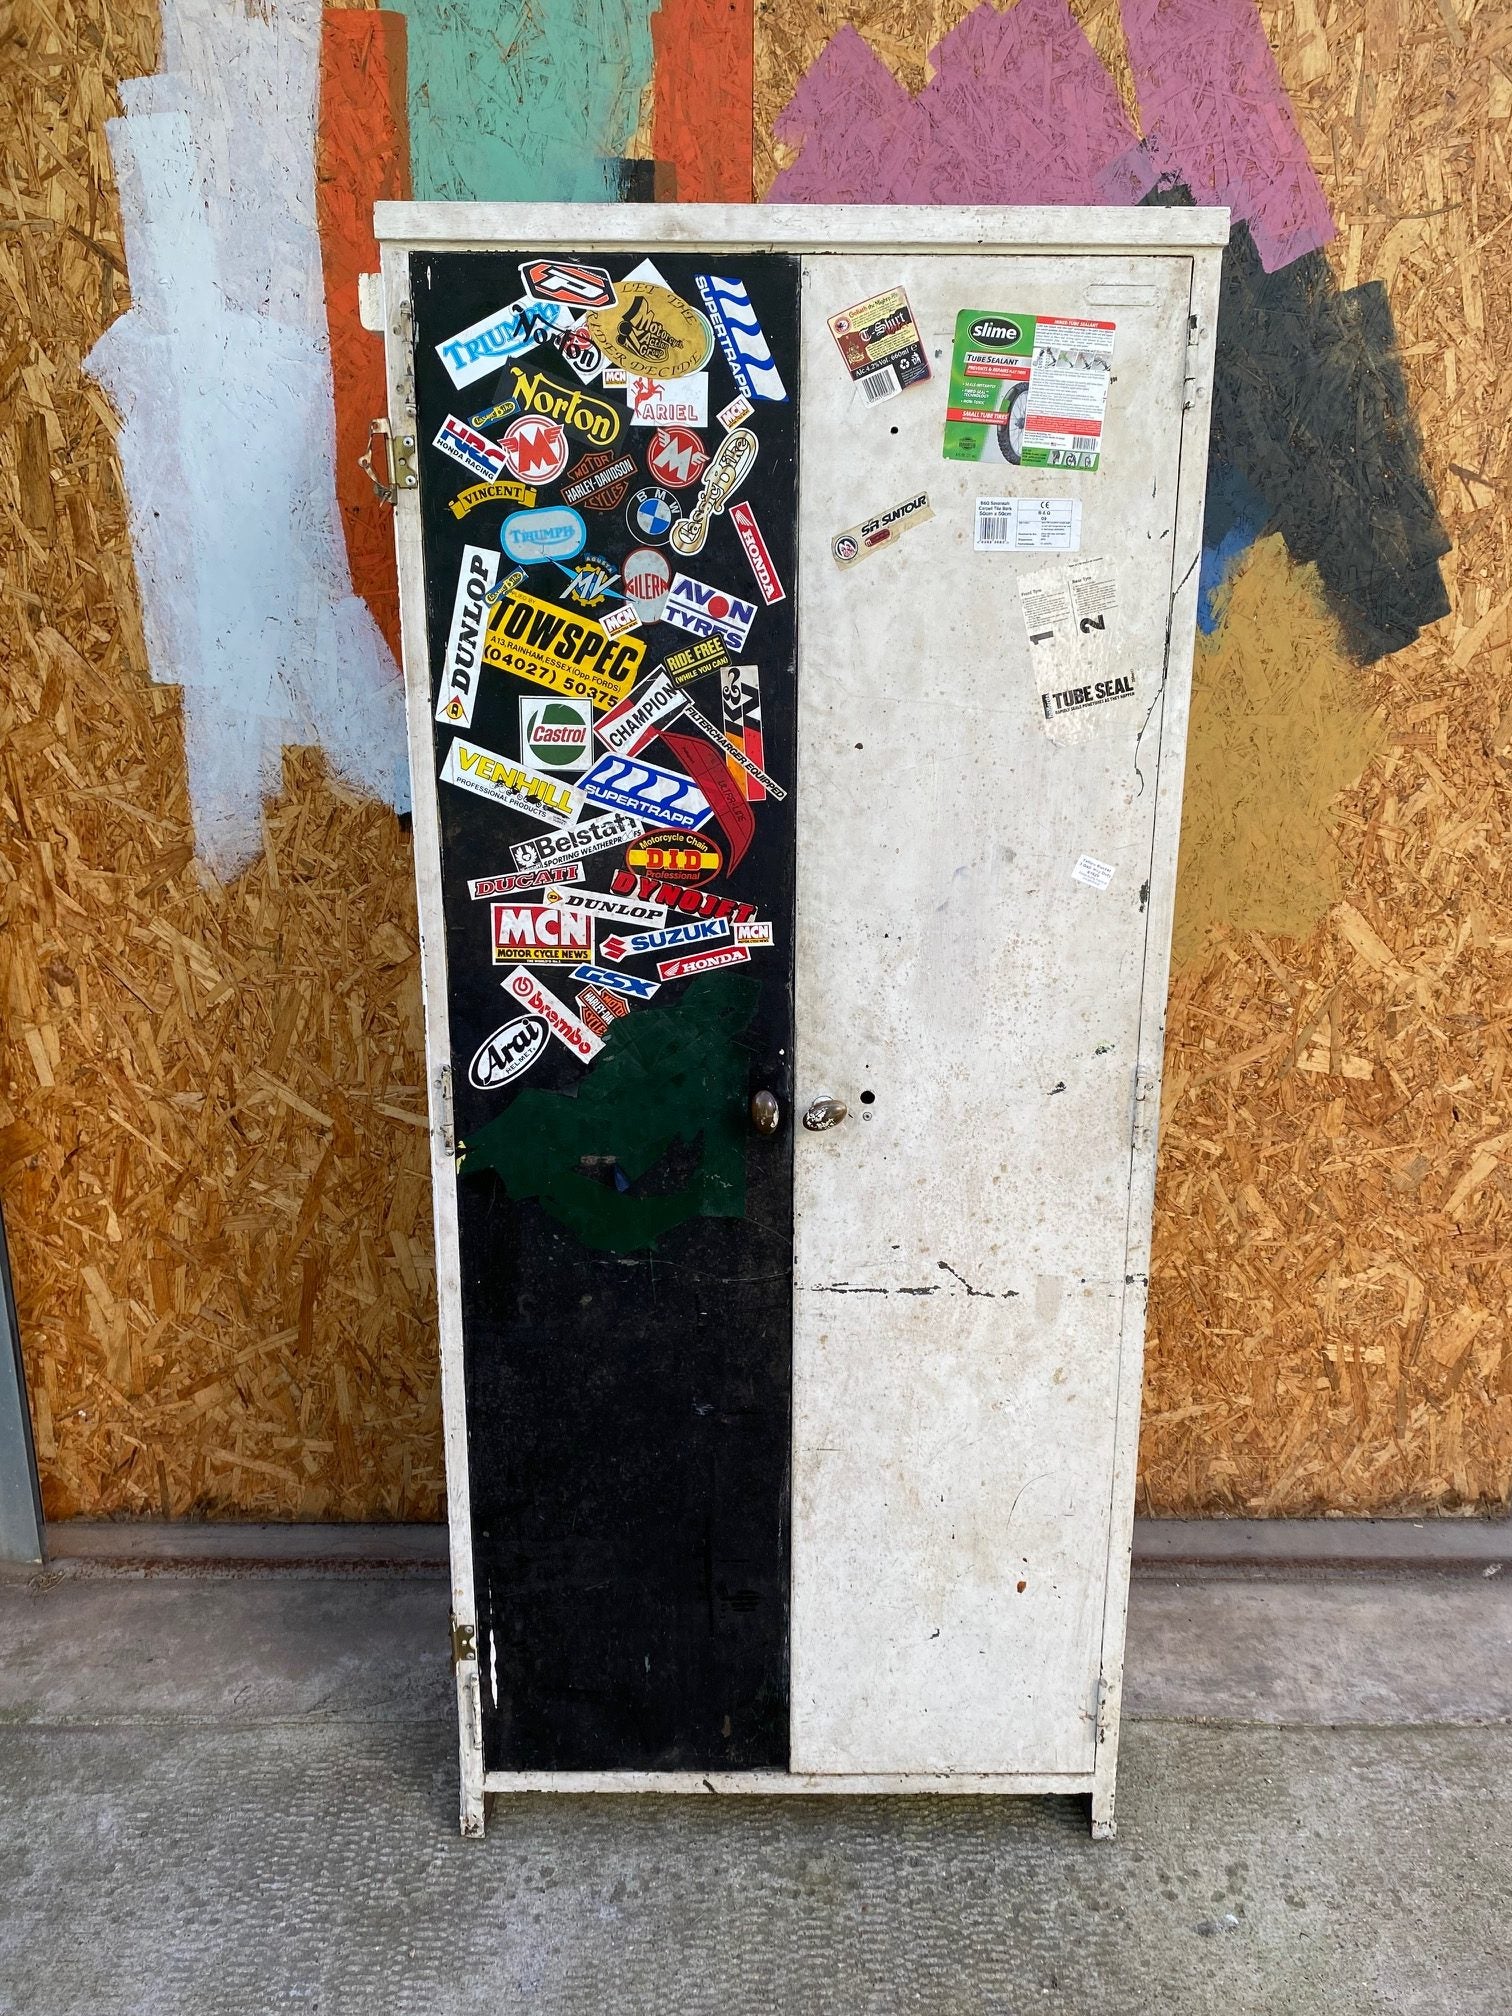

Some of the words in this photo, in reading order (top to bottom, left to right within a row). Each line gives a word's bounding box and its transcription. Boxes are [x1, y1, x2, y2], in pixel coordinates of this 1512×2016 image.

[621, 282, 660, 293] LET
[667, 294, 698, 326] THE
[512, 304, 602, 373] Norton
[587, 310, 627, 366] RIDER
[630, 352, 702, 377] DECIDE
[641, 335, 671, 350] Action
[695, 276, 752, 399] SUPERTRAPP
[973, 322, 1017, 340] slime
[640, 345, 665, 358] Group
[890, 347, 910, 361] 660ml
[967, 354, 987, 363] TUBE
[986, 356, 1019, 366] SEALANT
[605, 371, 626, 382] MCN
[510, 366, 621, 446] Norton
[642, 404, 699, 421] ARIEL
[722, 399, 748, 424] MCN
[963, 410, 980, 418] SMALL
[437, 438, 466, 461] HONDA
[465, 456, 495, 482] RACING
[574, 454, 611, 478] MOTOR
[463, 485, 523, 505] VINCENT
[564, 458, 635, 503] HARLEY-DAVIDSON
[588, 482, 626, 507] CYCLES
[861, 519, 880, 538] SR
[881, 495, 927, 526] SUNTOUR
[510, 525, 576, 545] TRIUMPH
[741, 528, 775, 600] HONDA
[559, 570, 621, 600] MV
[626, 573, 669, 600] GILERA
[673, 578, 754, 625] AVON
[451, 554, 489, 696] DUNLOP
[605, 608, 637, 631] MCN
[665, 605, 744, 649] TYRES
[1080, 614, 1106, 634] 2
[488, 598, 639, 682] TOWSPEC
[666, 651, 696, 671] RIDE
[695, 636, 725, 662] FREE
[484, 644, 557, 684] (04027)
[562, 677, 620, 708] 50375
[545, 657, 572, 673] ESSEX
[591, 676, 621, 693] FORDS)
[675, 669, 698, 684] (WHILE
[698, 662, 713, 676] YOU
[712, 655, 730, 670] CAN)
[1052, 685, 1093, 709] TUBE
[1095, 676, 1134, 699] SEAL
[609, 681, 677, 748] CHAMPION
[532, 724, 587, 744] Castrol
[685, 706, 747, 765] FILTERCHARGER
[744, 760, 786, 799] EQUIPPED
[458, 745, 573, 814] VENHILL
[456, 776, 509, 803] PROFESSIONAL
[508, 798, 547, 819] PRODUCTS
[585, 784, 694, 826] SUPERTRAPP
[538, 812, 637, 860] Belstaff
[639, 833, 684, 850] Motorcycle
[686, 834, 709, 852] Chain
[544, 851, 580, 868] SPORTING
[645, 869, 701, 880] Professional
[475, 865, 578, 897] DUCATI
[611, 870, 757, 924] DYNOJET
[565, 894, 664, 920] DUNLOP
[498, 908, 588, 946] MCN
[631, 918, 727, 951] SUZUKI
[738, 925, 769, 939] MCN
[497, 948, 532, 959] MOTOR
[534, 948, 560, 959] CYCLE
[561, 949, 589, 960] NEWS
[682, 949, 746, 974] HONDA
[575, 964, 657, 998] GSX
[527, 990, 591, 1054] brembo
[483, 1018, 541, 1085] Arai
